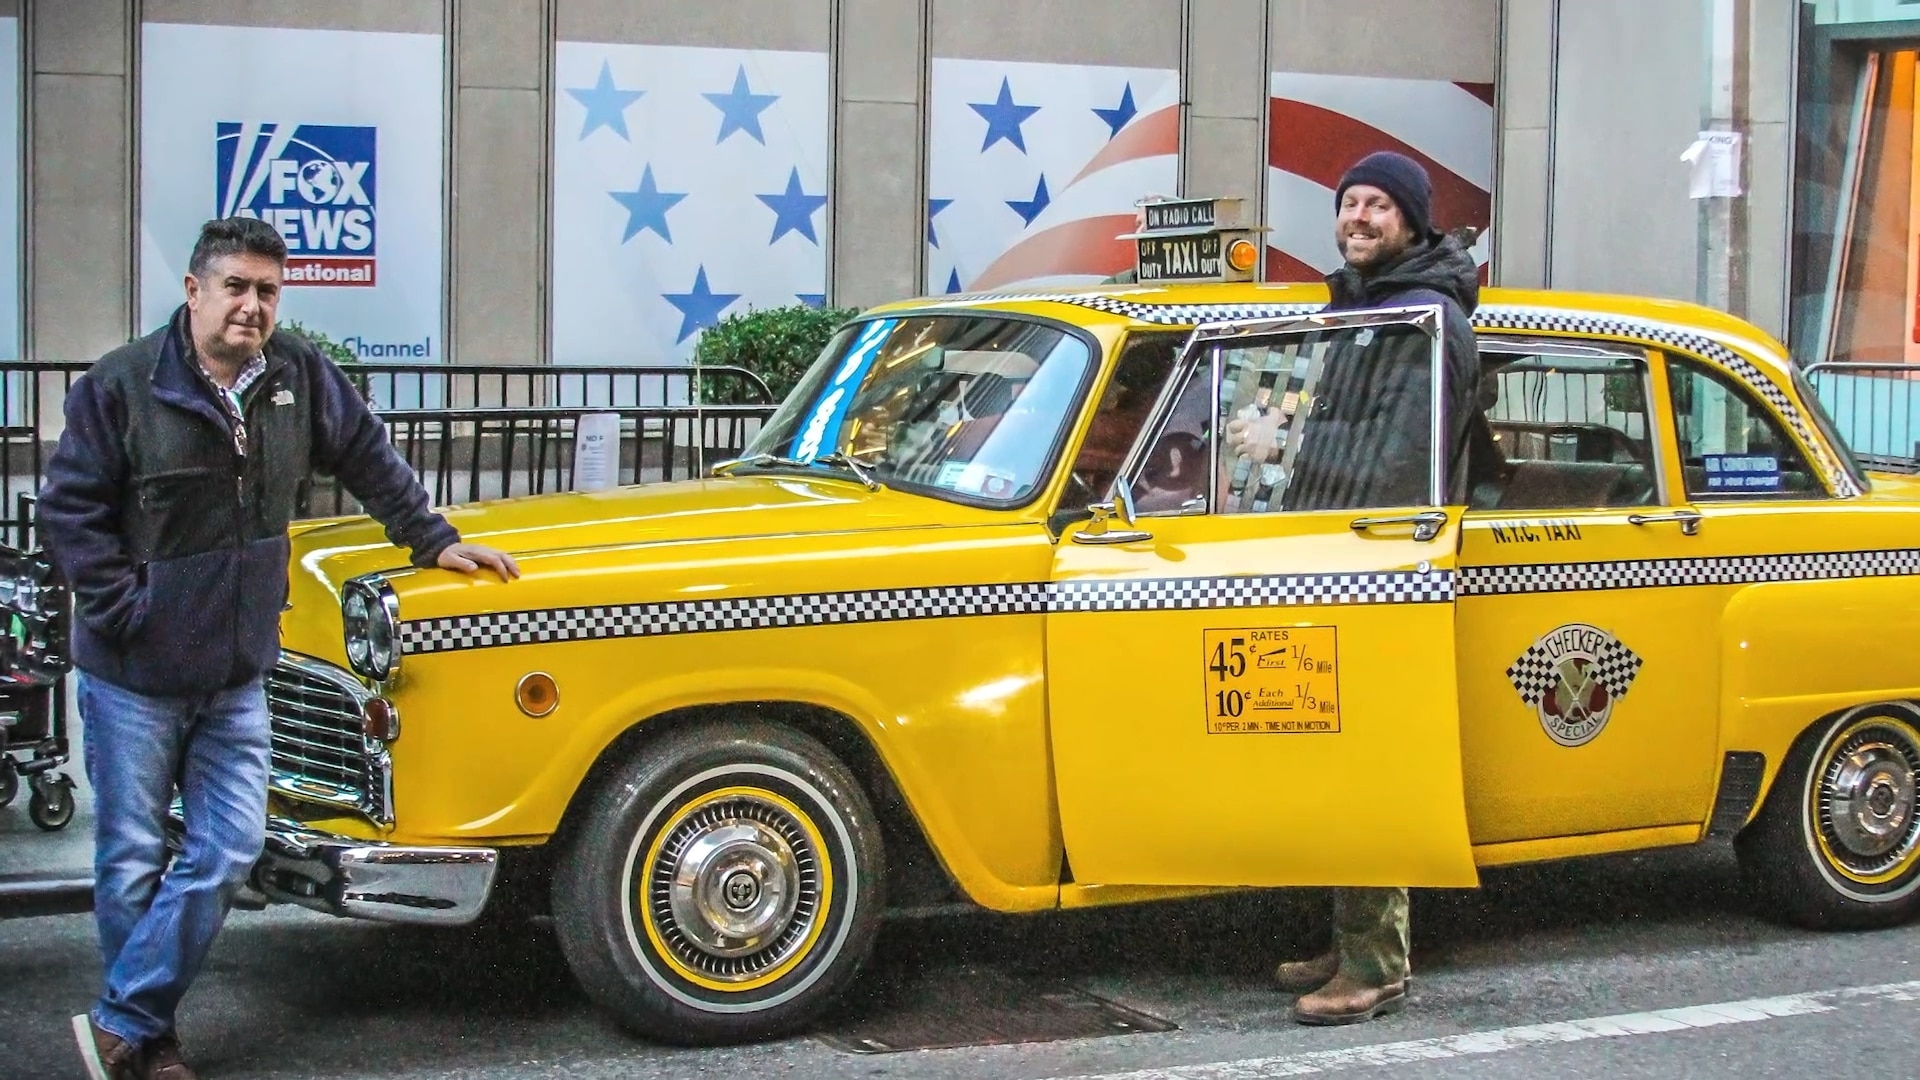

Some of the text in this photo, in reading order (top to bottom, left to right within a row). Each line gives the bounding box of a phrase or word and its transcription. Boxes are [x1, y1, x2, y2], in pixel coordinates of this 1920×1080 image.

[270, 159, 371, 205] FOX
[1148, 205, 1214, 226] ON RADIO CALL
[241, 208, 372, 250] EWS
[1141, 241, 1156, 256] OFF
[1202, 238, 1218, 254] OFF
[1162, 241, 1198, 275] TAXI
[1201, 258, 1221, 274] DUTY
[1142, 263, 1162, 279] DUTY
[1488, 519, 1582, 543] N.Y.C. TAXI
[1251, 631, 1289, 641] RATES
[1546, 629, 1604, 659] CHECKER
[1257, 650, 1286, 667] First
[1291, 644, 1314, 671] 1/6
[1316, 661, 1332, 673] Mile
[1259, 687, 1284, 698] Each
[1295, 682, 1335, 713] 1/3 Mile
[1253, 699, 1295, 707] Additional
[1265, 722, 1281, 731] TIME
[1281, 722, 1296, 730] NOT
[1304, 721, 1330, 730] MOTION
[1550, 717, 1600, 737] SPECIAL
